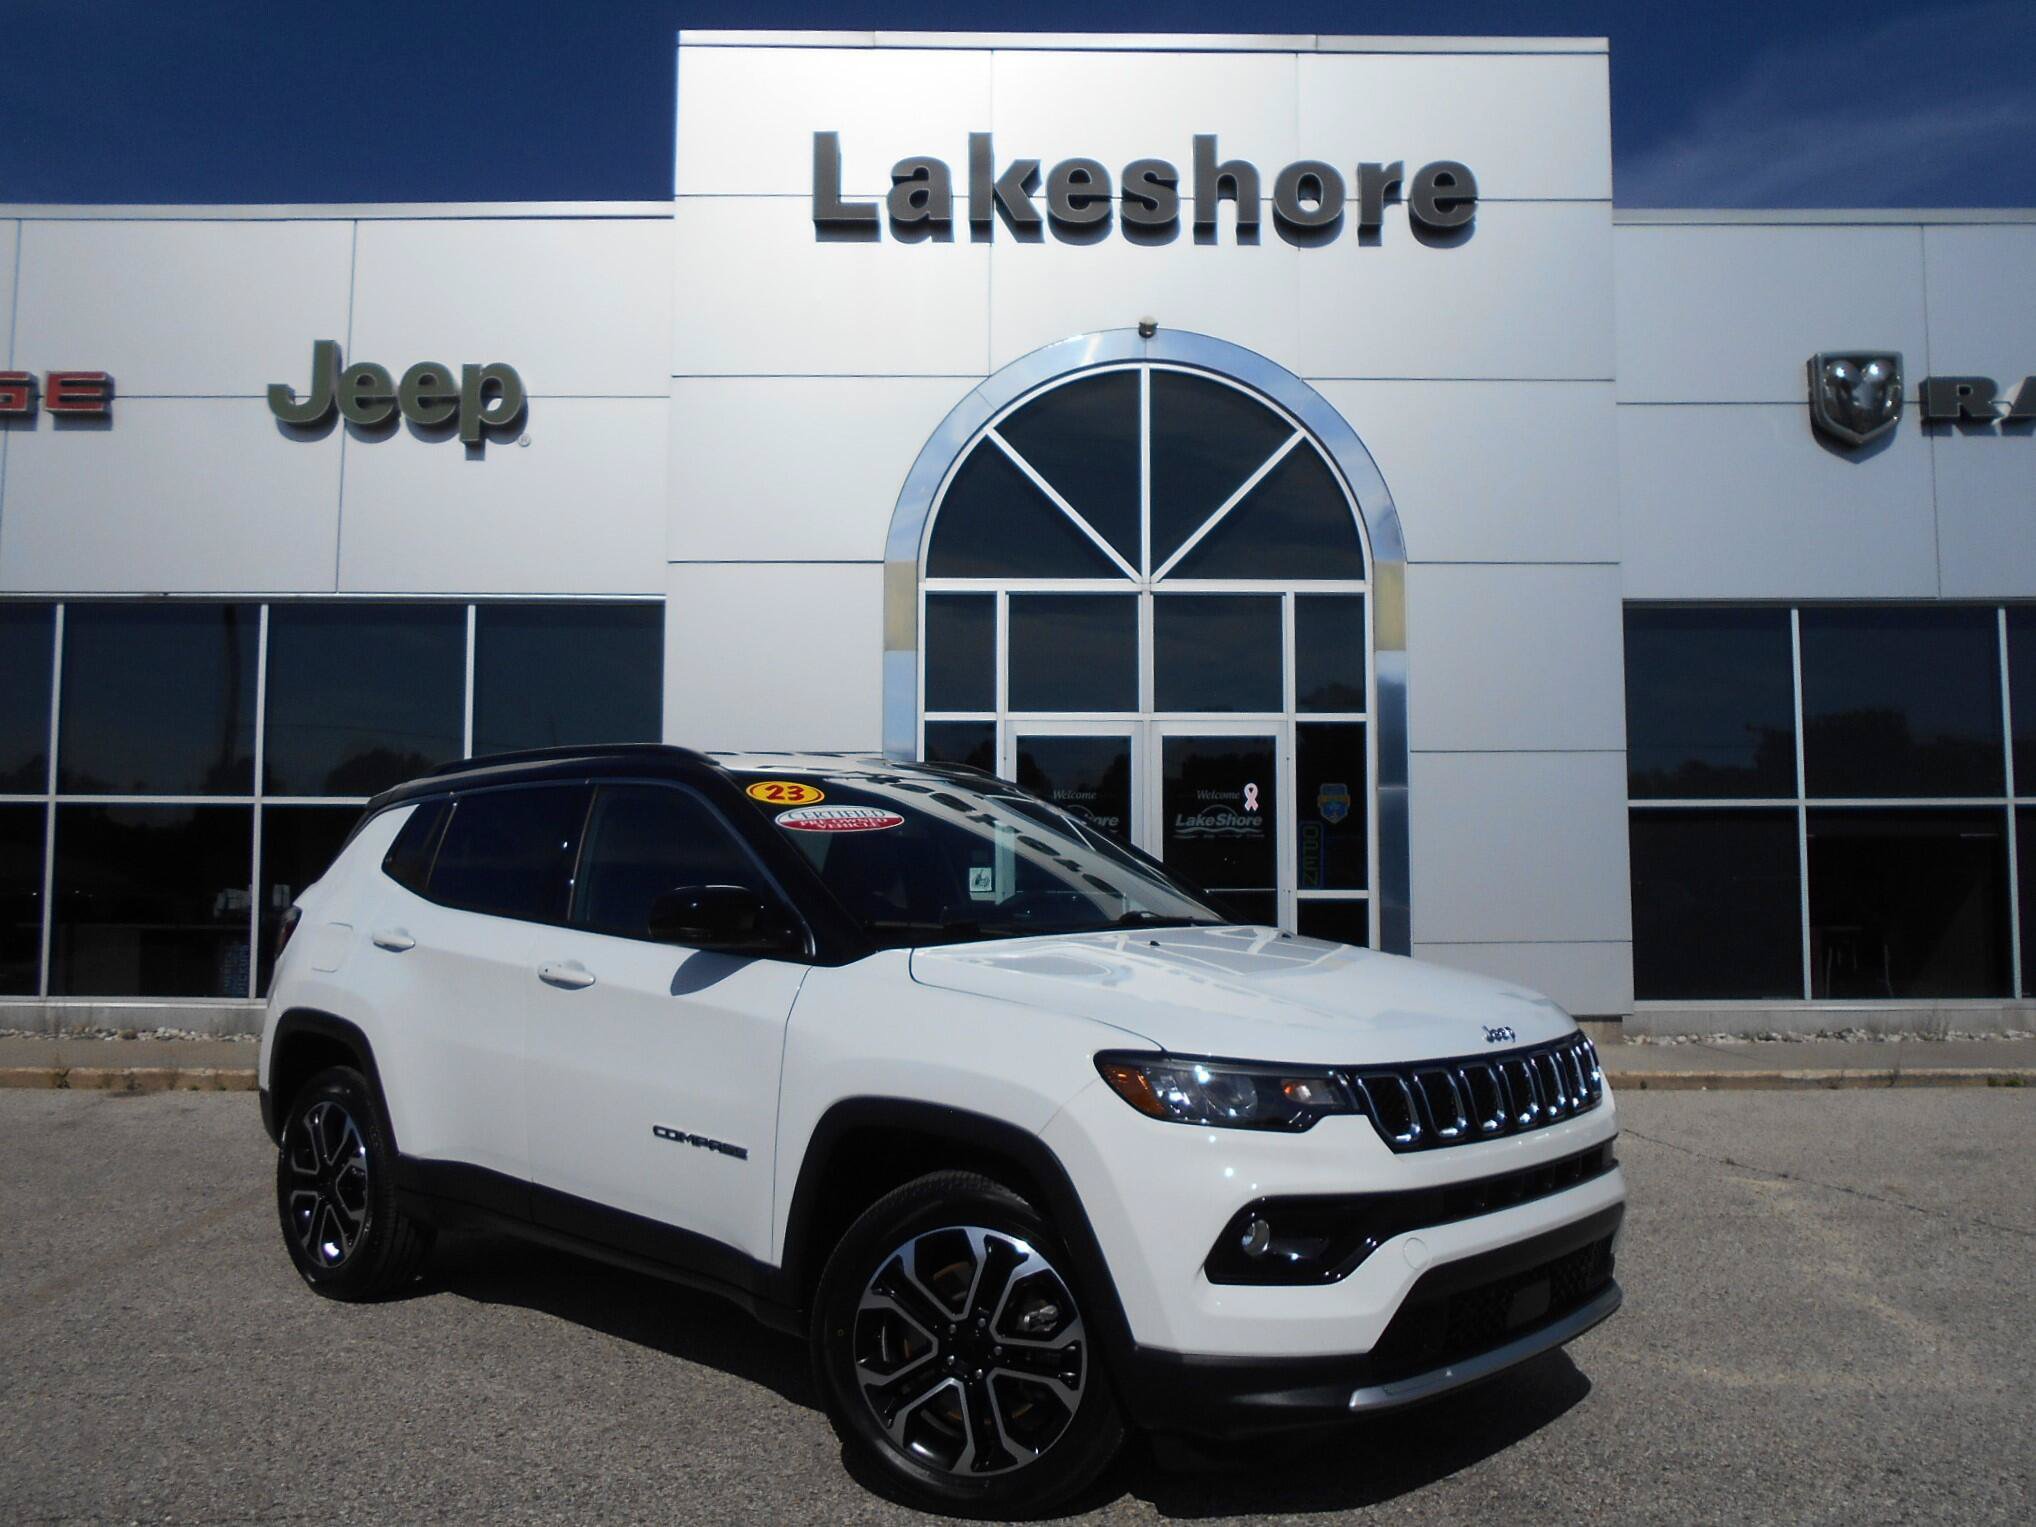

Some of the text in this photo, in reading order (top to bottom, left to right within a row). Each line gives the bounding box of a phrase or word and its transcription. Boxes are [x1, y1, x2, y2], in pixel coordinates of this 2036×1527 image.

[812, 131, 1479, 243] Lakeshore
[267, 340, 526, 450] Jeep
[765, 785, 804, 801] 23
[1052, 788, 1097, 800] Welcome
[1197, 789, 1241, 801] Welcome
